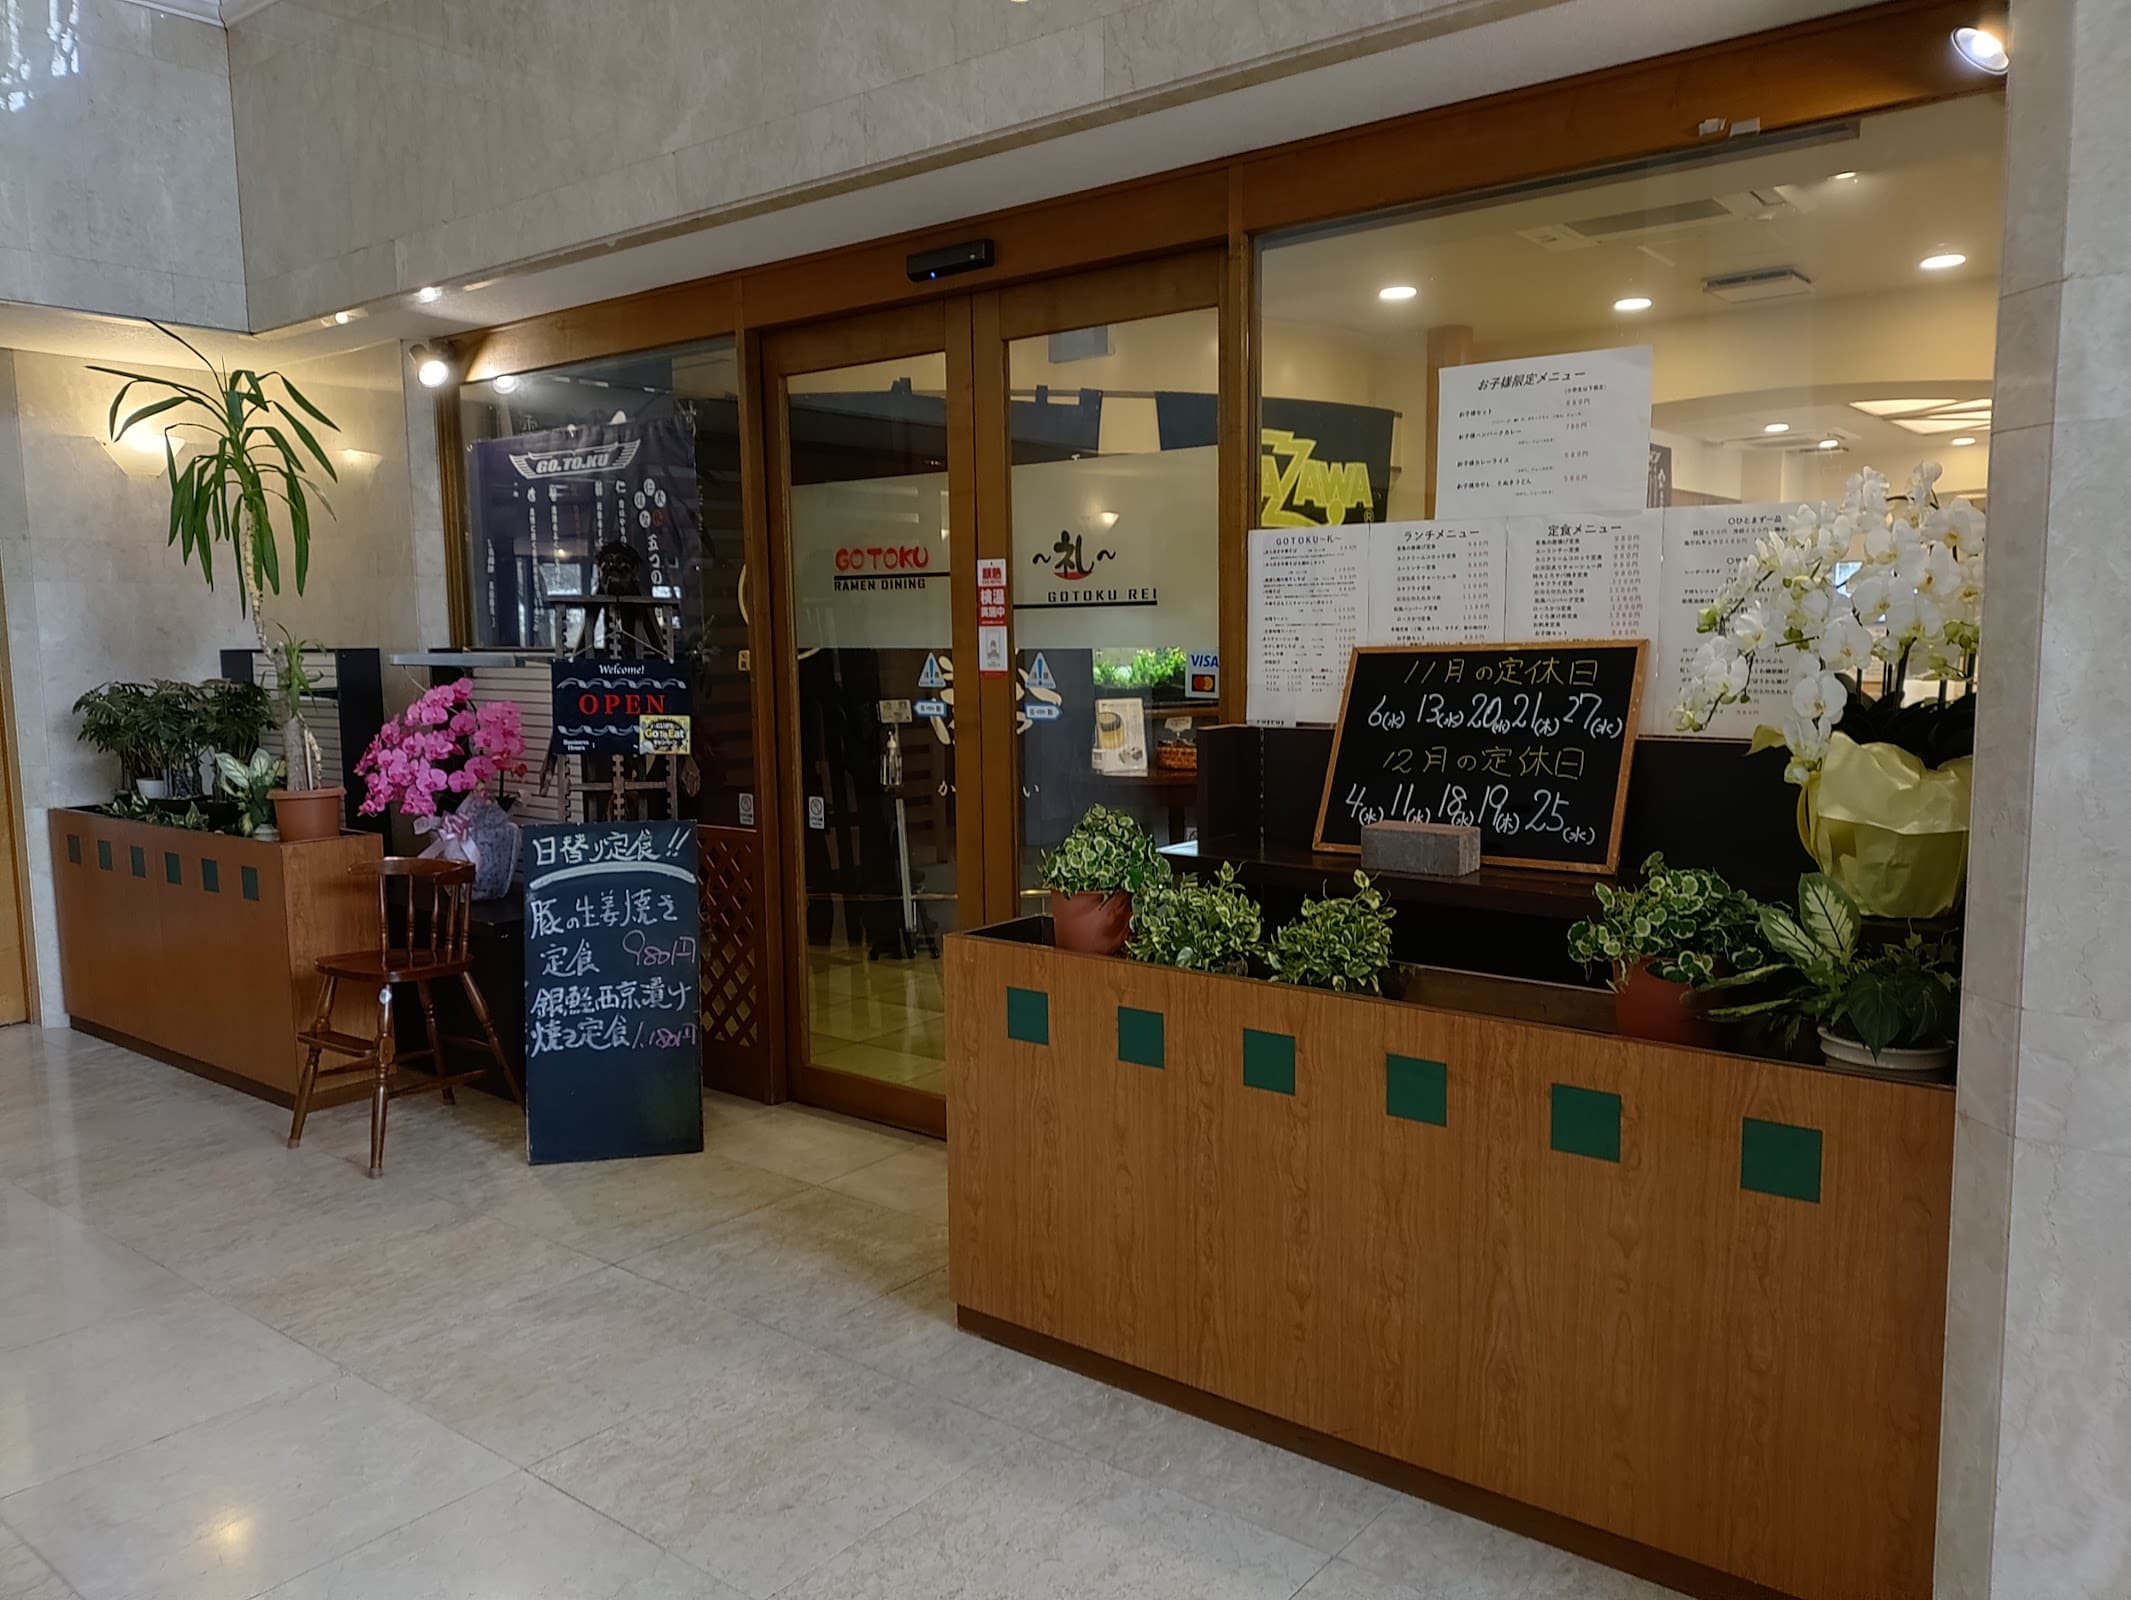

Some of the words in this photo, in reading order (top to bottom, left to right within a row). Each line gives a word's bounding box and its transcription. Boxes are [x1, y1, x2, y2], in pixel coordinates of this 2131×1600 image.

[1478, 371, 1585, 391] お子様限定メニュー
[536, 453, 609, 474] GO.TO.KU
[1405, 529, 1480, 541] ランチメニュー
[1548, 524, 1622, 537] 定食メニュー
[835, 545, 929, 571] GOTOKU
[834, 580, 876, 592] RAMEN
[881, 578, 926, 590] DINING
[1048, 589, 1117, 602] GOTOKU
[1128, 588, 1157, 600] REI
[600, 663, 645, 674] Welcome!
[1191, 655, 1219, 668] VISA
[1404, 657, 1597, 685] 11月の定休日
[579, 694, 666, 715] OPEN
[1382, 746, 1584, 779] 12月の定休日
[530, 889, 678, 940] 豚の生姜焼き
[540, 938, 600, 977] 定食
